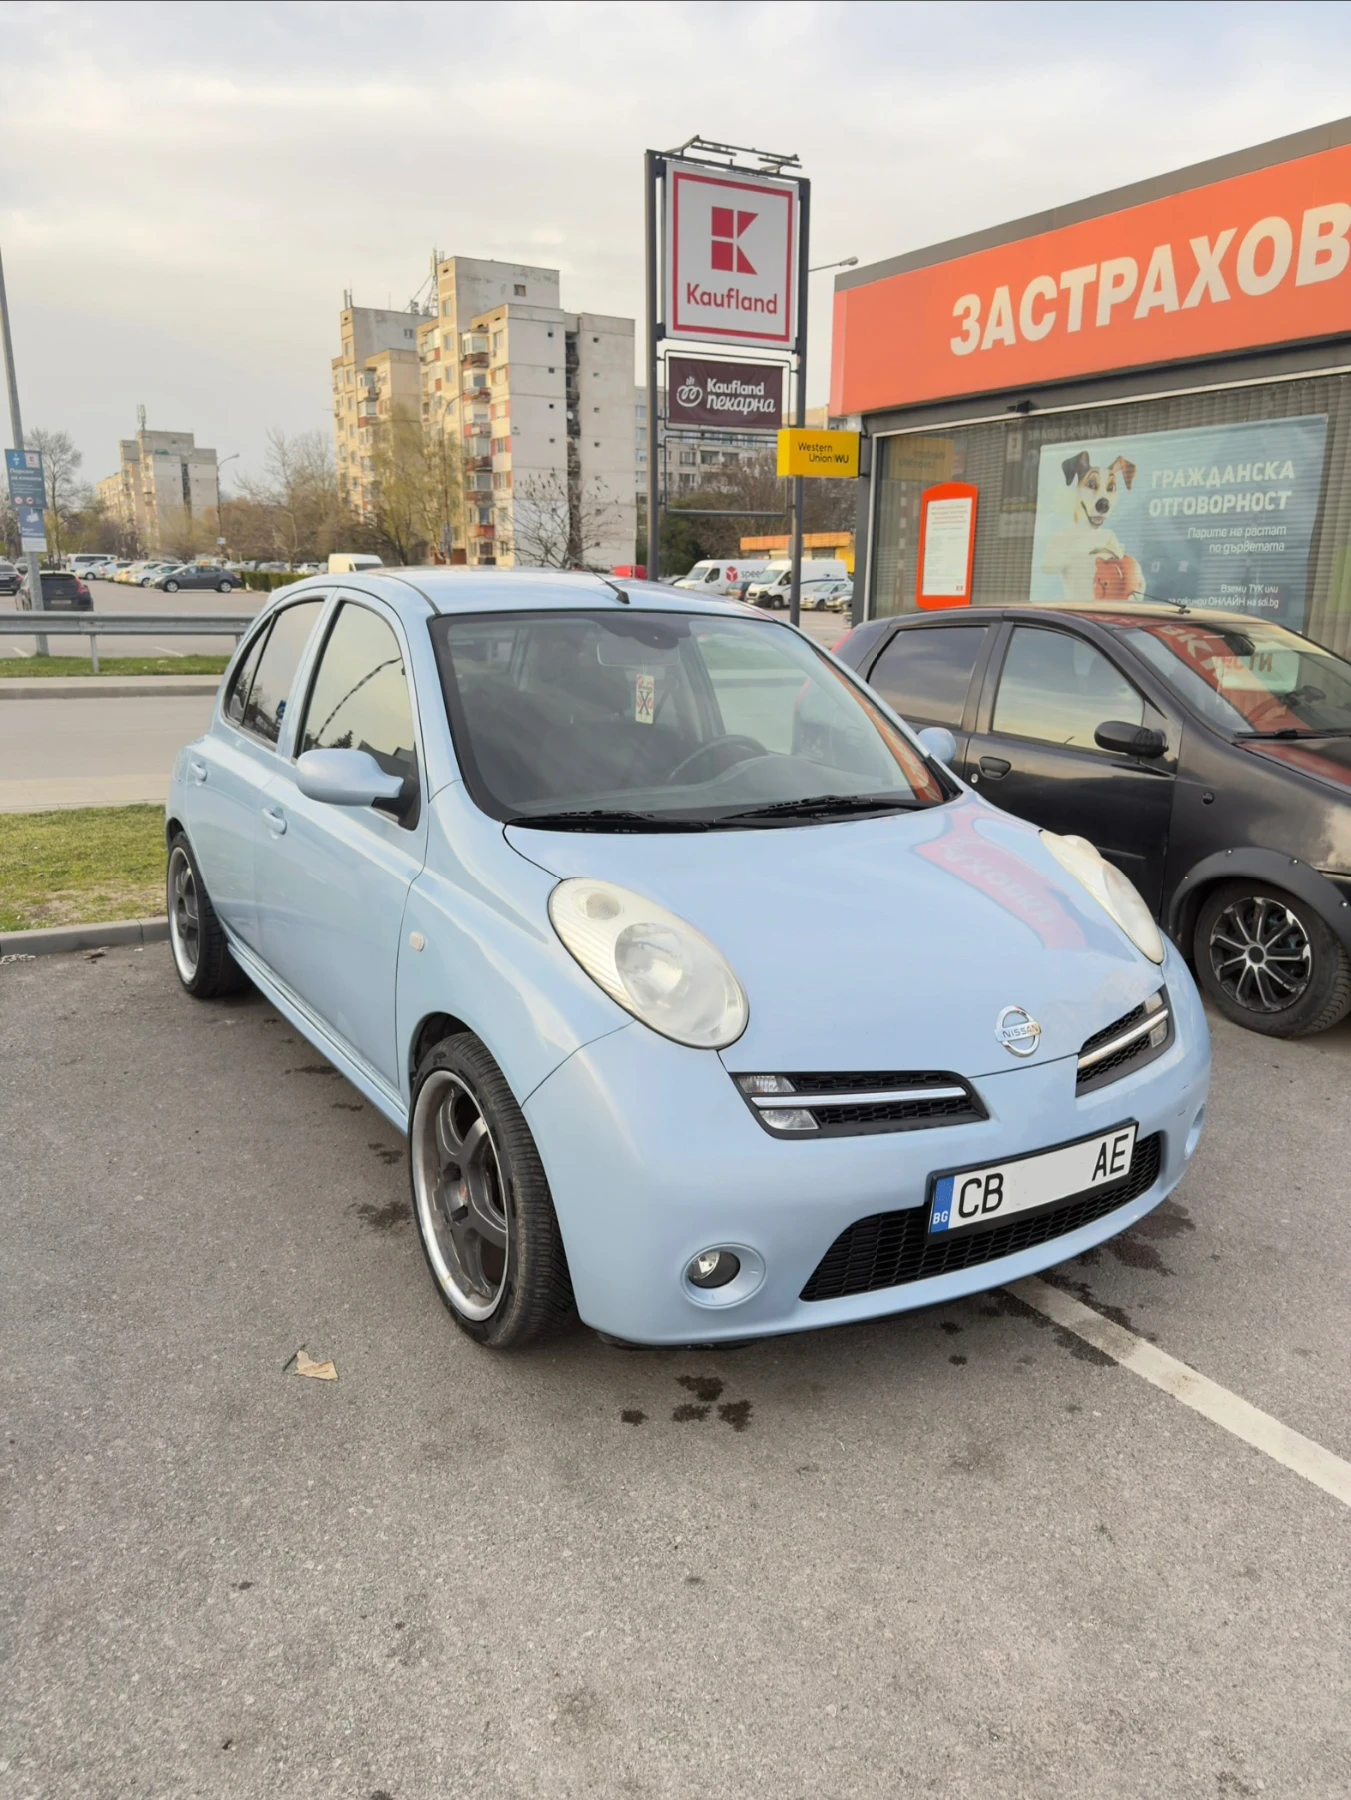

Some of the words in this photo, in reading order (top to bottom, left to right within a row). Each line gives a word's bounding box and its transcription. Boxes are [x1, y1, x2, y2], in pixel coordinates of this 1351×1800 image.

[950, 202, 1351, 356] ЗАСТРАХОВ
[686, 283, 777, 315] Kaufland
[706, 378, 764, 396] Kaufland
[706, 395, 776, 415] пекарна
[798, 442, 833, 453] Western
[809, 453, 832, 463] Union
[834, 454, 849, 464] WU
[1151, 460, 1295, 489] ГРАЖДАНСКА
[1149, 490, 1292, 517] ОТГОВОРНОСТ
[1187, 527, 1227, 540] Парите
[1230, 528, 1243, 537] не
[1244, 525, 1287, 539] растат
[1209, 543, 1221, 553] по
[1223, 540, 1285, 555] дърветата
[1220, 584, 1247, 594] Вземи
[1249, 584, 1264, 593] ТУК
[1264, 585, 1279, 593] или
[1208, 595, 1246, 606] ОНЛАЙН
[1246, 598, 1257, 607] на
[1002, 1023, 1039, 1038] NISSAN
[958, 1172, 1004, 1219] CB
[1091, 1133, 1130, 1182] AE
[932, 1211, 949, 1225] BG
